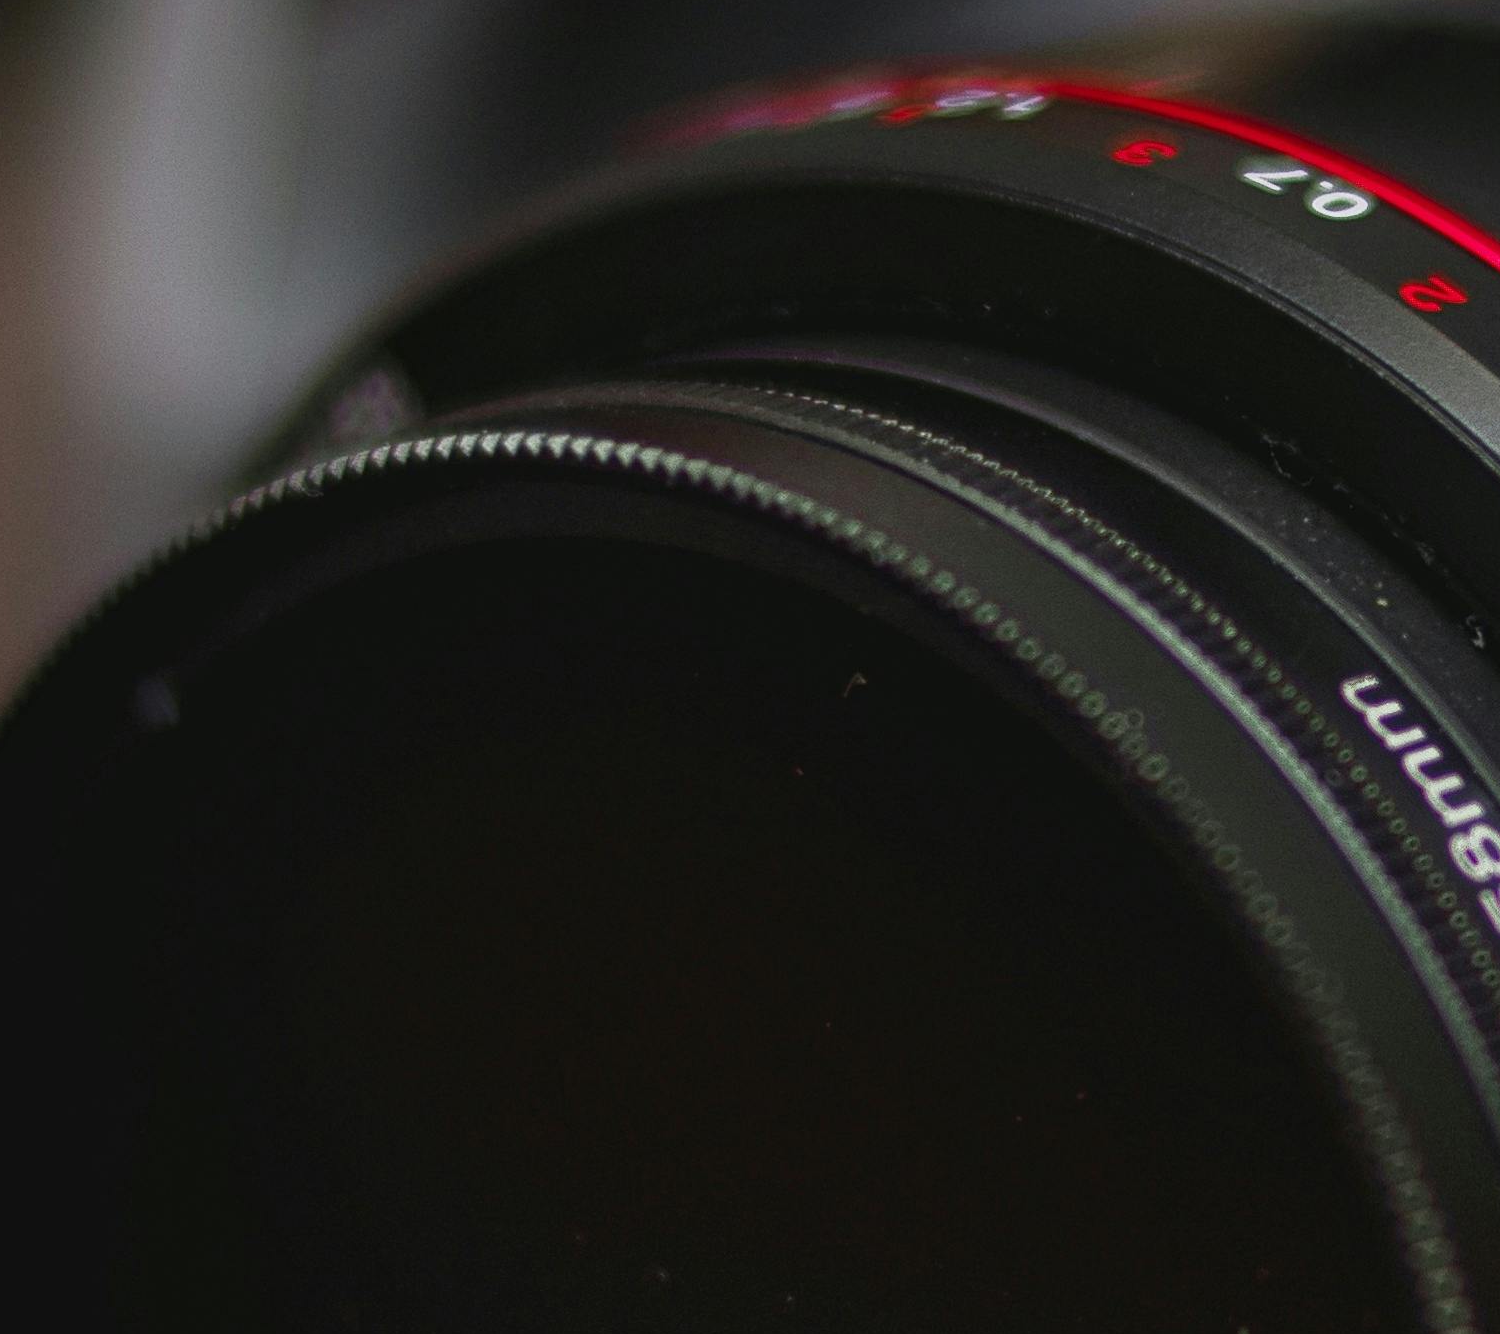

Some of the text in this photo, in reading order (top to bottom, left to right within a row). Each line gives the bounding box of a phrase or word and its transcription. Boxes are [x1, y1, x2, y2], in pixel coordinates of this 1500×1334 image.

[1112, 139, 1178, 166] 3
[1241, 167, 1371, 220] 0.7
[1398, 276, 1469, 314] 2
